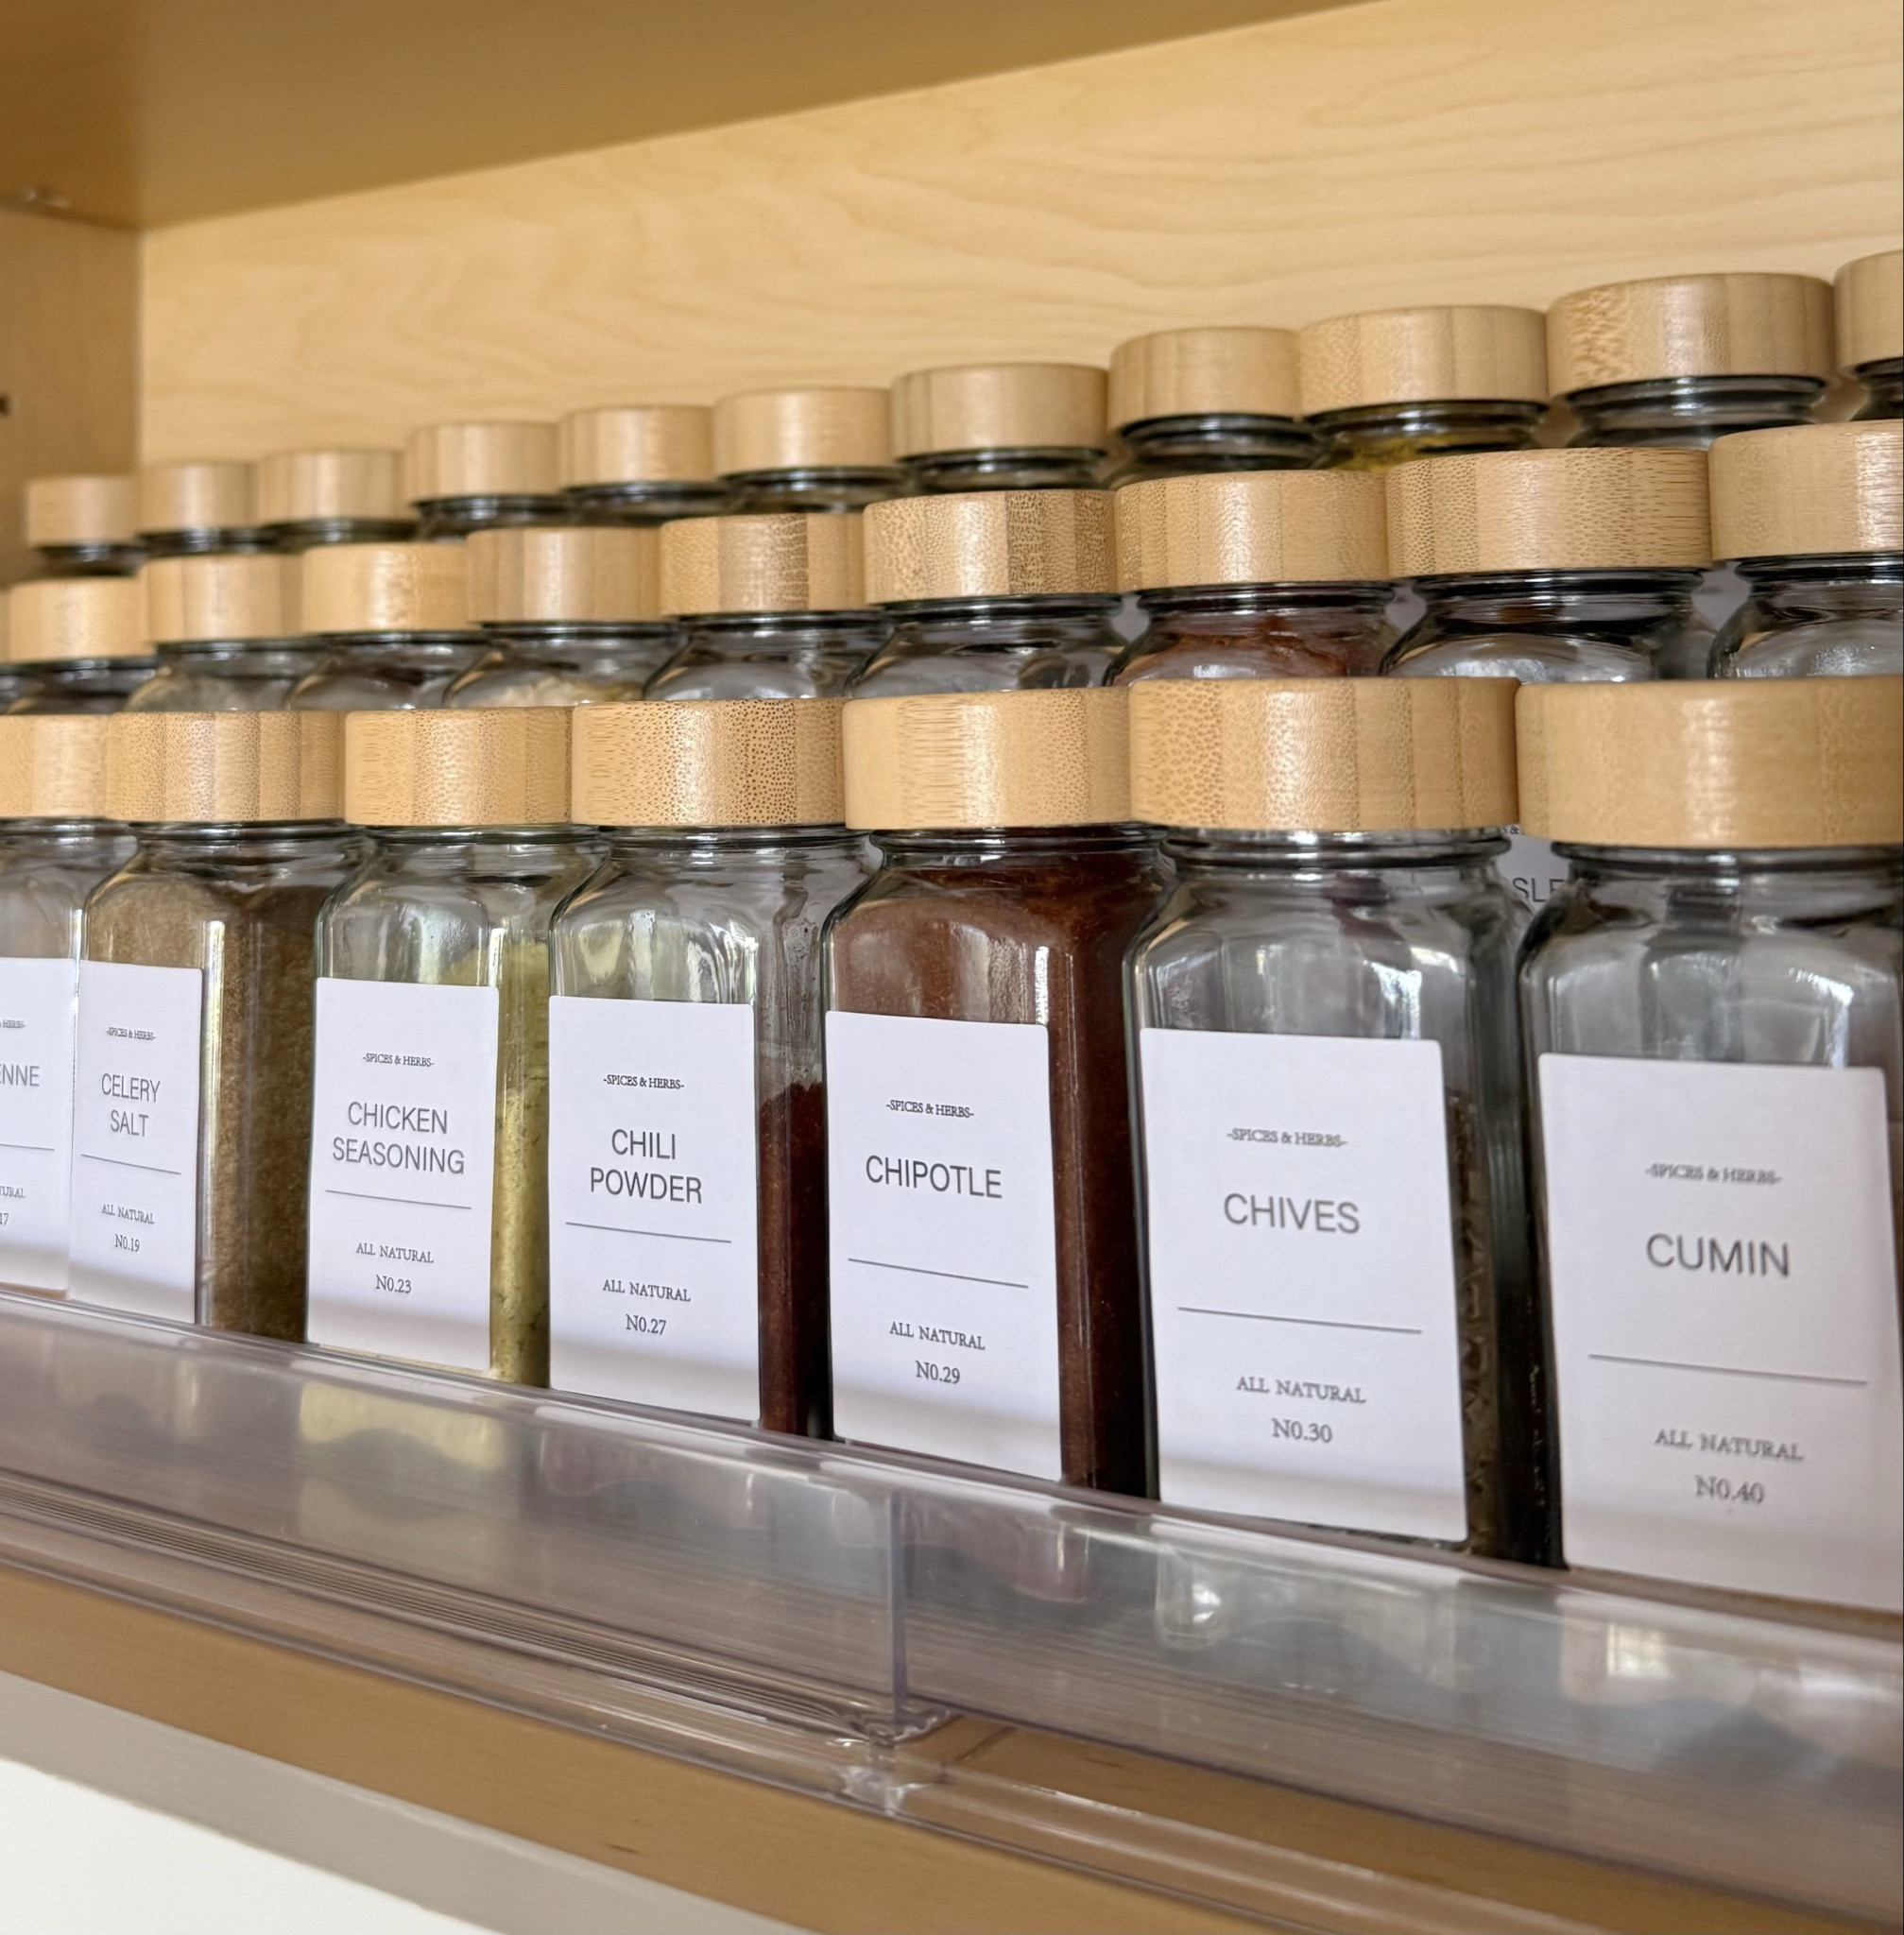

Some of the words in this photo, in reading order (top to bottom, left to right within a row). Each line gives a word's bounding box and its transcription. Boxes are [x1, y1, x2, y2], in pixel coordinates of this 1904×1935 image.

[394, 1055, 401, 1065] &
[0, 1064, 40, 1087] NNE
[102, 1073, 160, 1103] CELERY
[640, 1077, 647, 1087] &
[111, 1109, 148, 1137] SALT
[349, 1102, 447, 1134] CHICKEN
[925, 1104, 934, 1114] &
[612, 1129, 676, 1159] CHILI
[1281, 1132, 1292, 1144] &
[333, 1137, 464, 1174] SEASONING
[591, 1167, 701, 1204] POWDER
[866, 1156, 1002, 1198] CHIPOTLE
[1707, 1168, 1719, 1181] &
[102, 1205, 115, 1216] ALL
[118, 1207, 154, 1224] NATURAL
[1224, 1193, 1360, 1234] CHIVES
[356, 1242, 376, 1256] ALL
[380, 1245, 434, 1263] NATURAL
[1646, 1234, 1789, 1277] CUMIN
[603, 1279, 625, 1293] ALL
[629, 1282, 691, 1302] NATURAL
[889, 1321, 914, 1338] ALL
[918, 1326, 986, 1350] NATURAL
[1236, 1377, 1270, 1394] ALL
[1276, 1379, 1366, 1404] NATURAL
[1655, 1430, 1693, 1448] ALL
[1700, 1433, 1803, 1462] NATURAL
